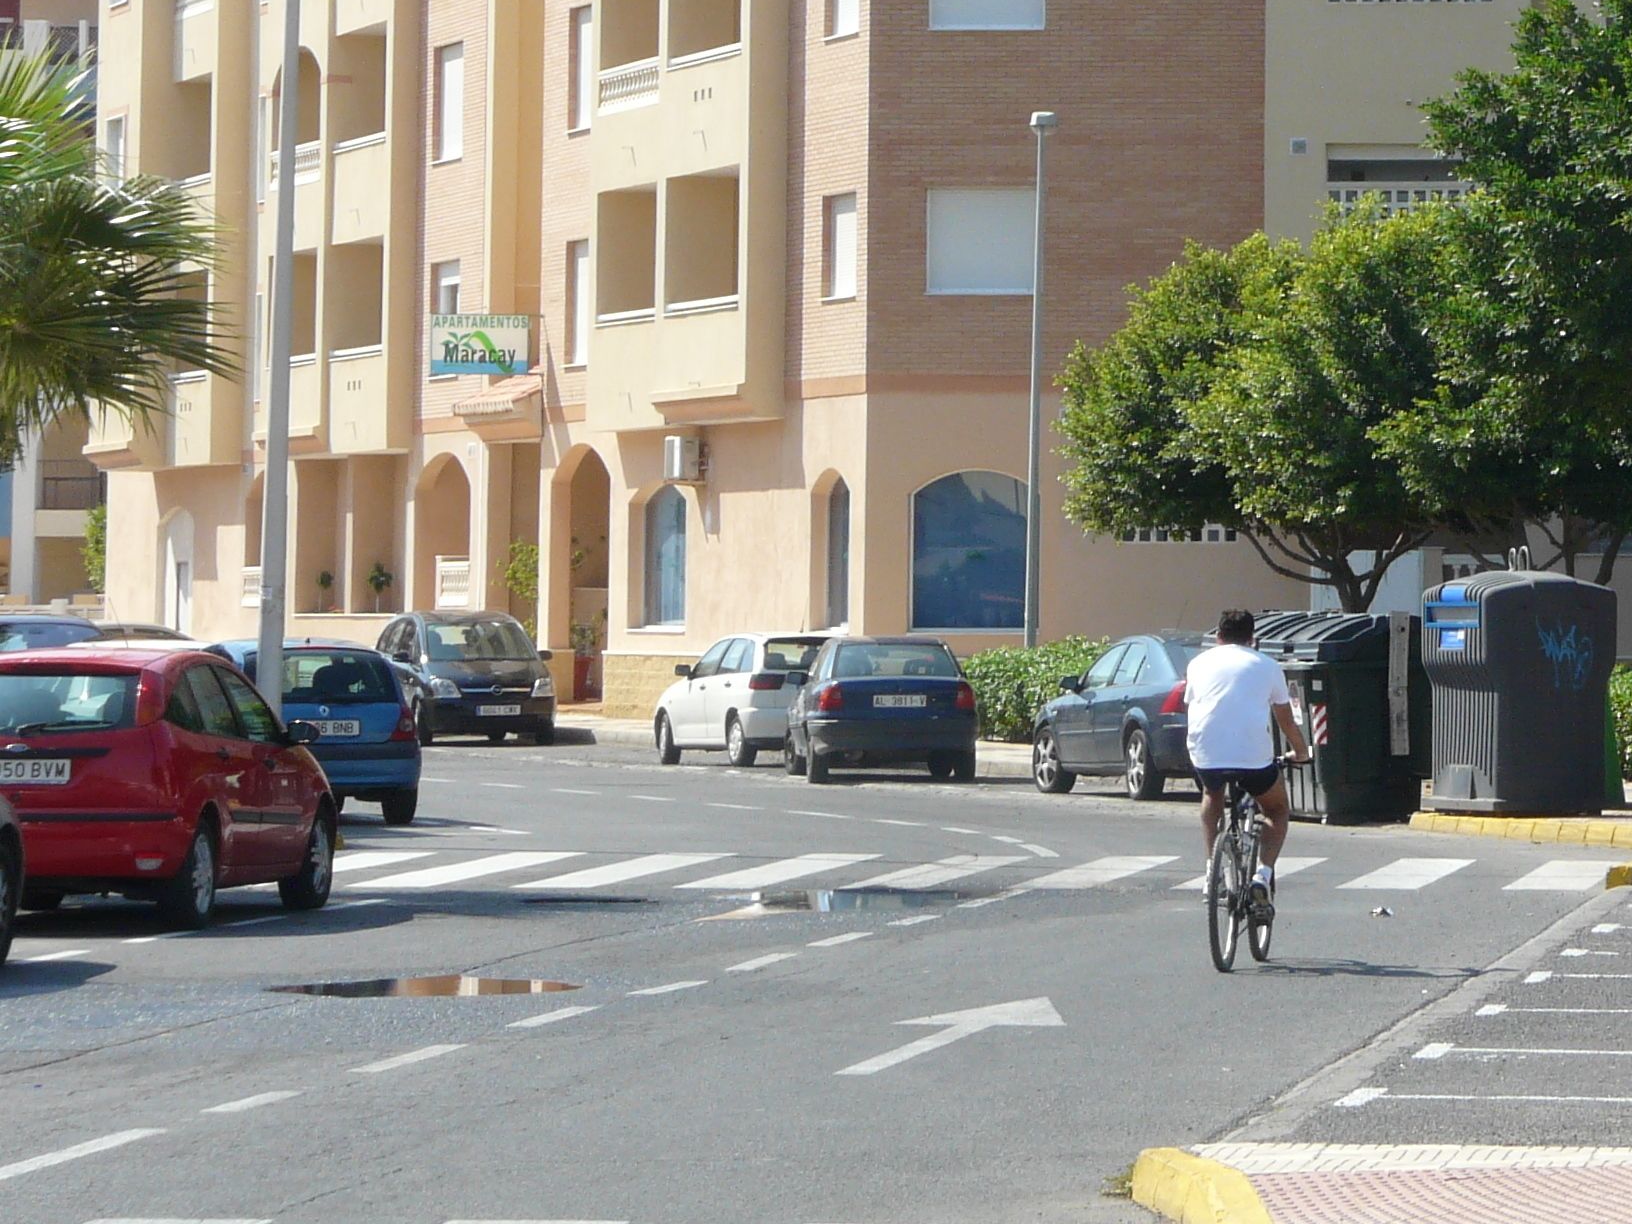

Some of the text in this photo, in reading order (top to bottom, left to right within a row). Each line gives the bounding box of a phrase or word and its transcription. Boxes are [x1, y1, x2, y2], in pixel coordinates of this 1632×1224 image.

[433, 316, 529, 328] APARTAMENTOS
[443, 343, 516, 368] Maracay
[31, 762, 66, 778] BVM
